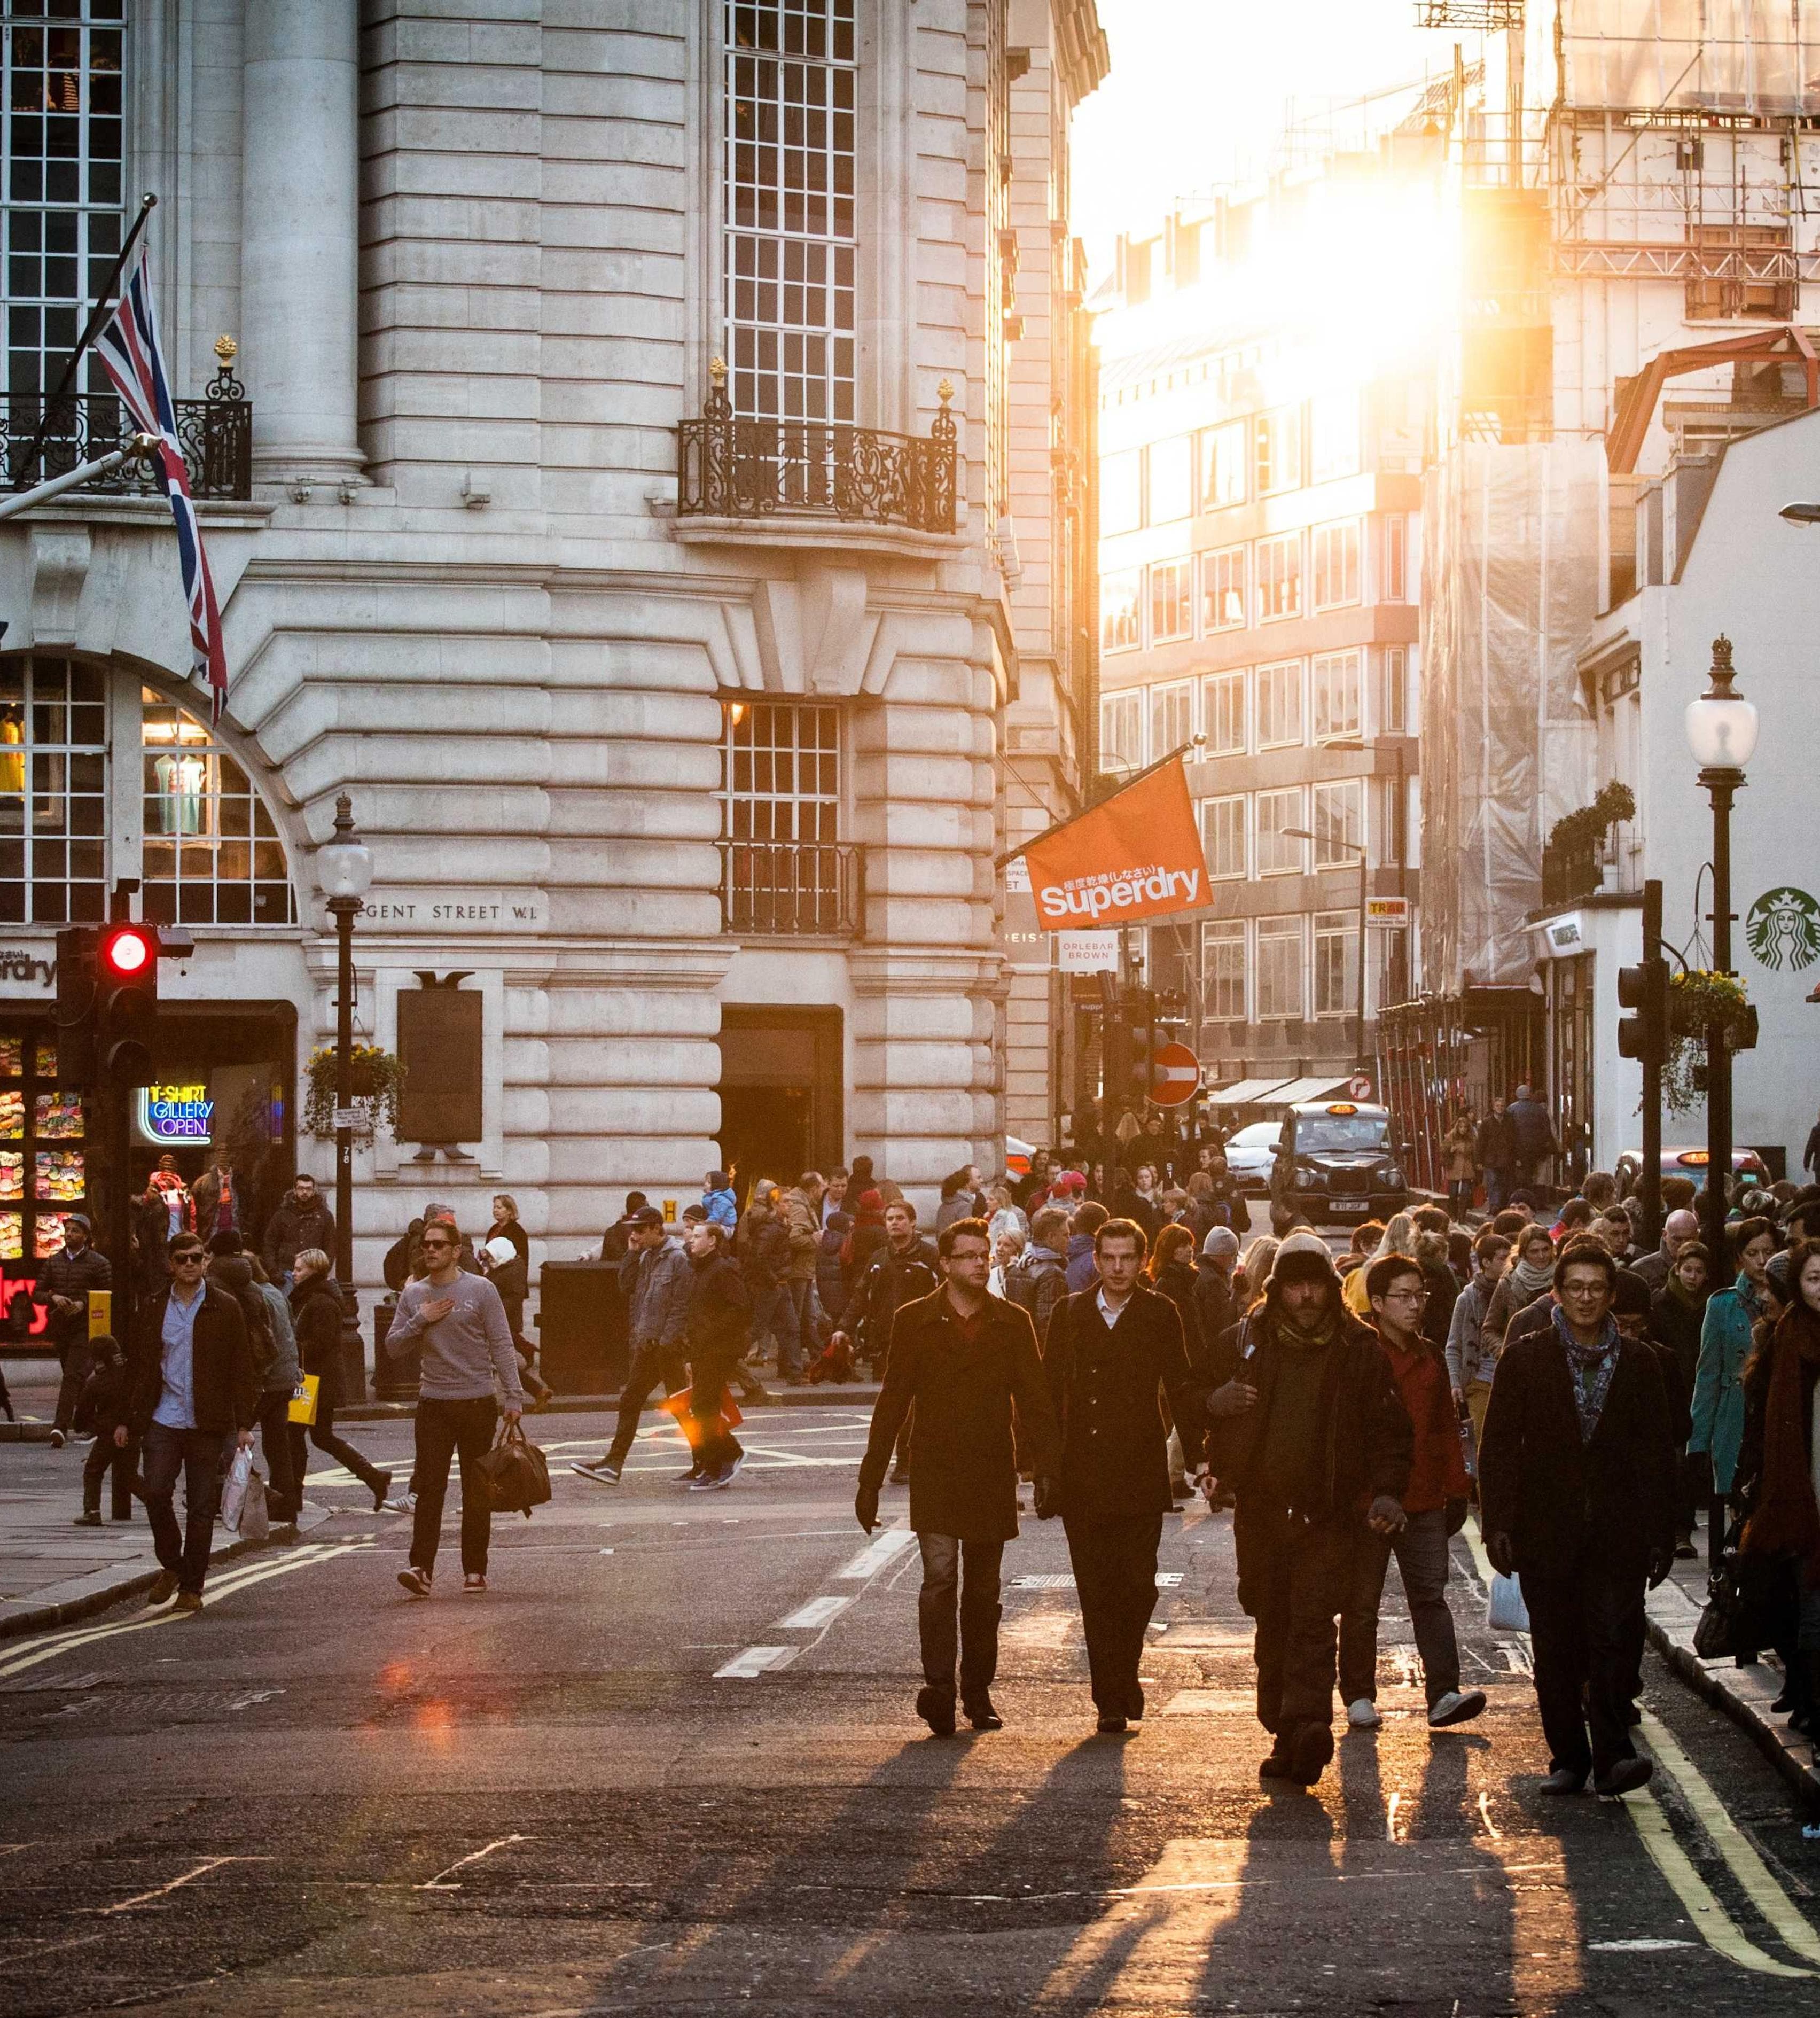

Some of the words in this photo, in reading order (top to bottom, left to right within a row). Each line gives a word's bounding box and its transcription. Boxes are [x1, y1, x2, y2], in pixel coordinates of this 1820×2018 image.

[1041, 866, 1199, 918] Superdry
[356, 905, 416, 918] GENT
[433, 906, 499, 919] STREET
[0, 954, 59, 987] rdry
[150, 1086, 206, 1102] T-SHIRT
[154, 1102, 214, 1118] GALLERY
